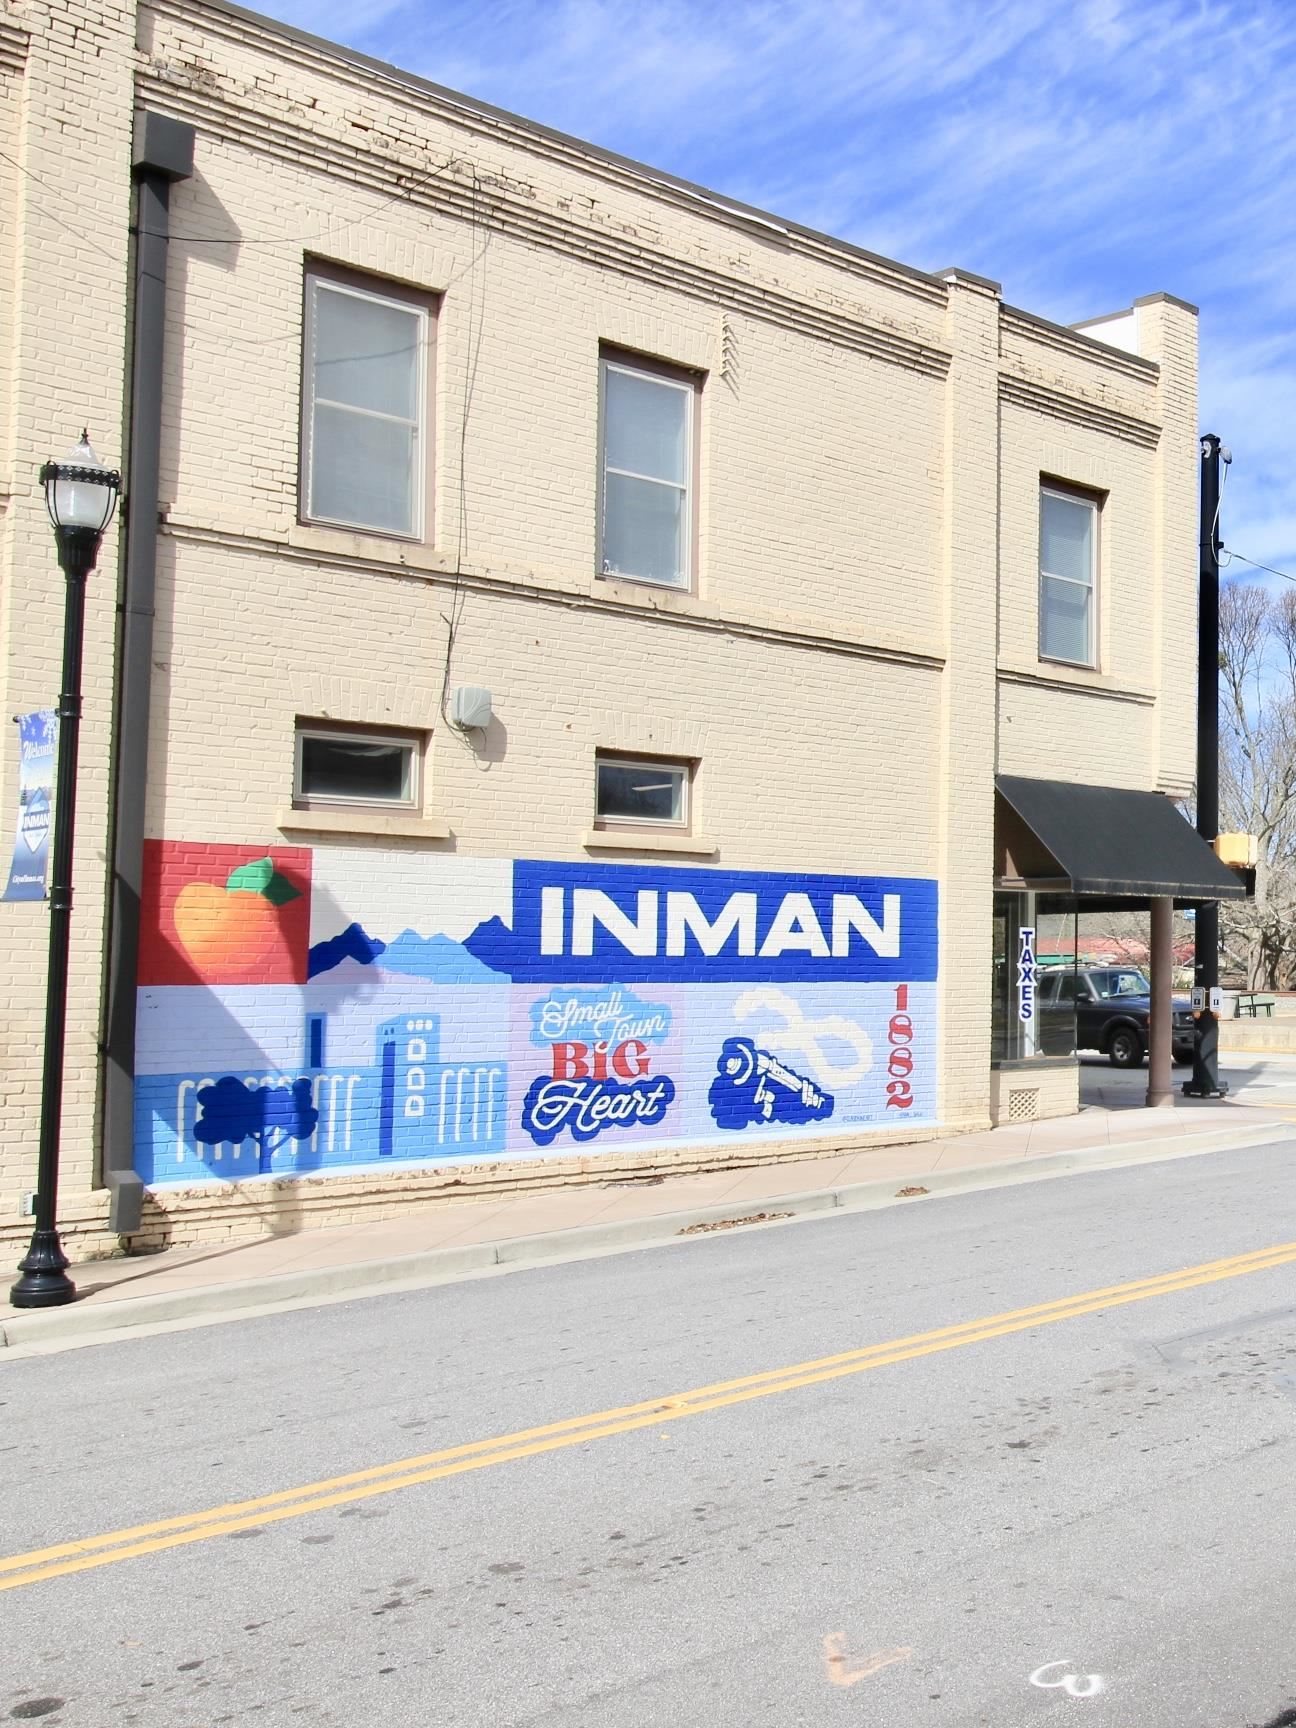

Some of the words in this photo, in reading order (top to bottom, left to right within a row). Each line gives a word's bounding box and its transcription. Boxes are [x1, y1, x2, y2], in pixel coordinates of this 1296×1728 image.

[541, 886, 901, 958] INMAN
[1021, 931, 1033, 1019] TAXES
[540, 990, 623, 1038] Small
[594, 1014, 666, 1054] Town
[883, 983, 914, 1110] 1882
[530, 1080, 666, 1133] Heart
